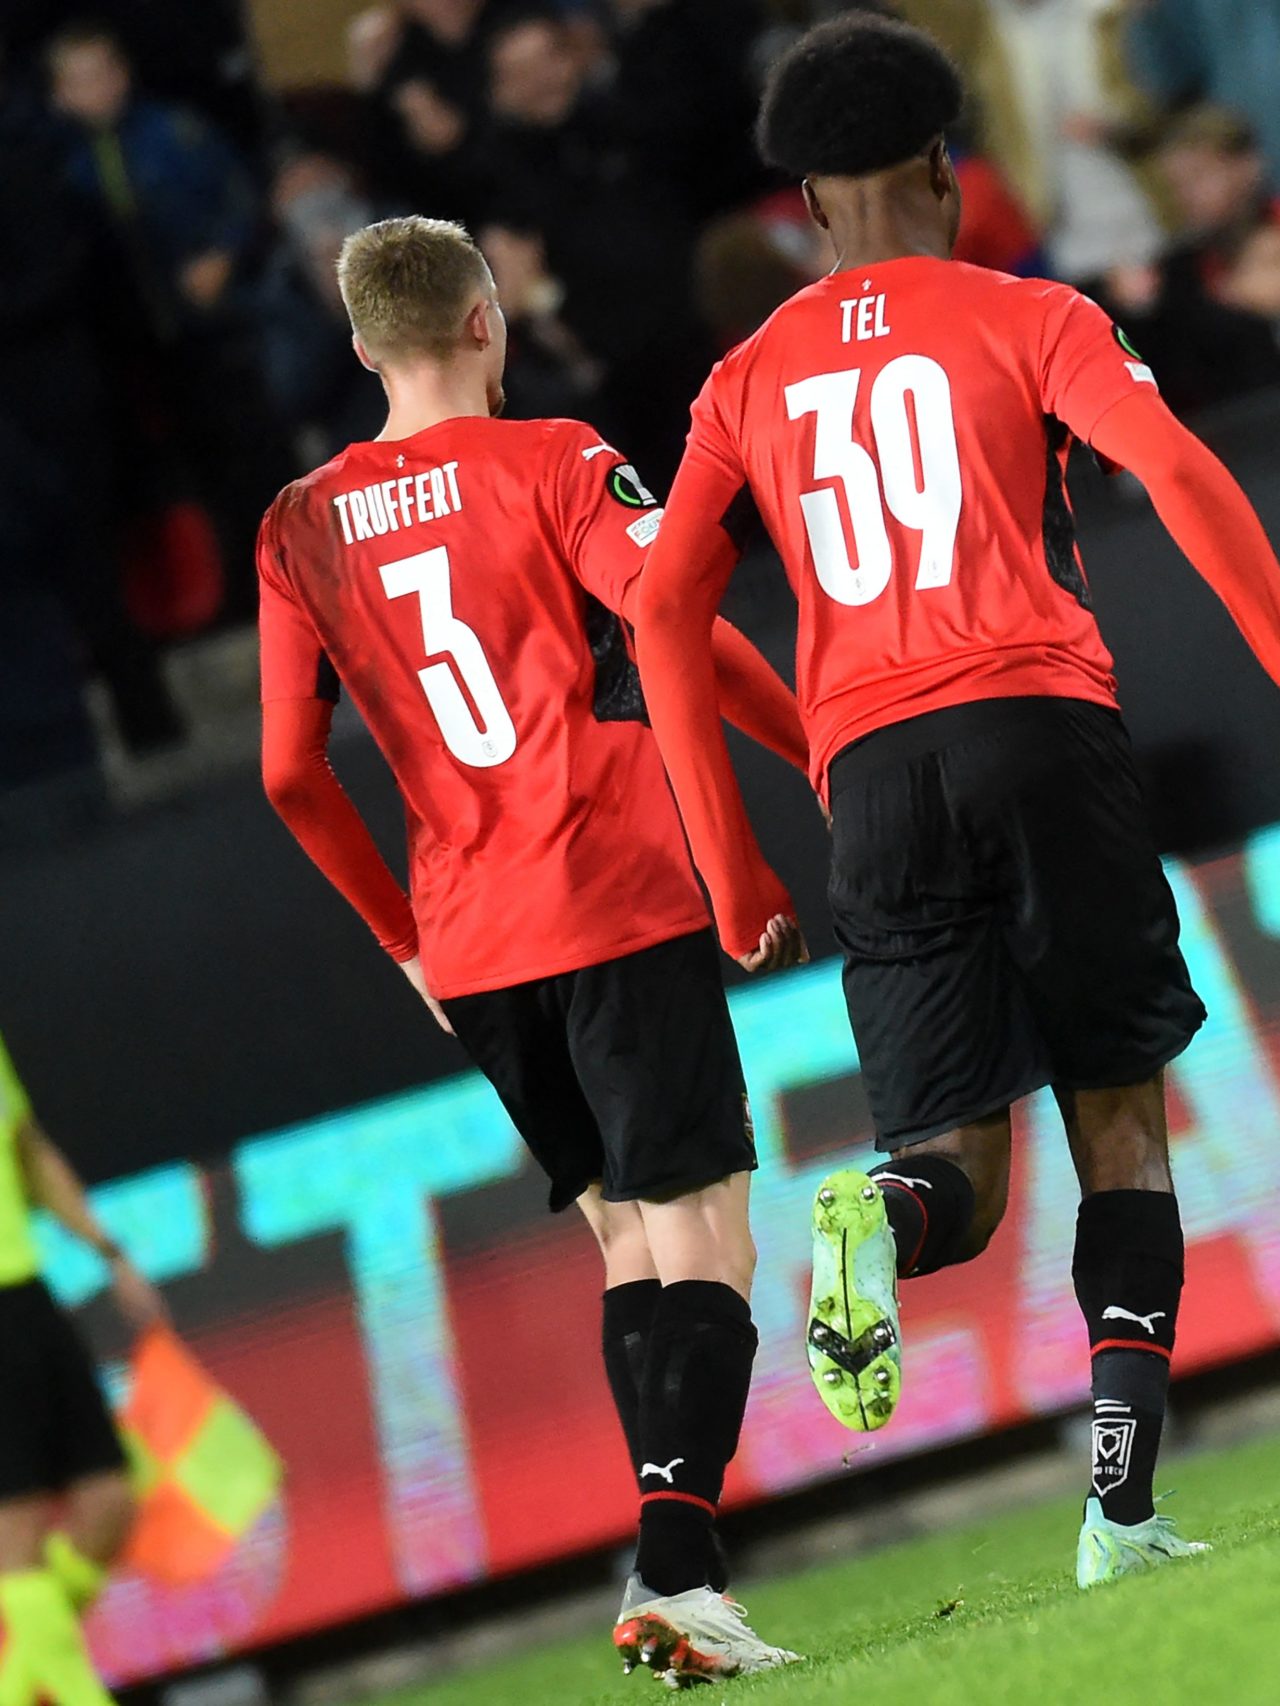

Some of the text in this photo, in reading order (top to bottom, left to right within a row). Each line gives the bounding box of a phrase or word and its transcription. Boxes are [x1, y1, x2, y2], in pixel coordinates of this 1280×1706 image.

[840, 293, 891, 344] TEL
[334, 461, 462, 545] TRUFFERT
[784, 354, 963, 607] 39
[378, 545, 517, 768] 3
